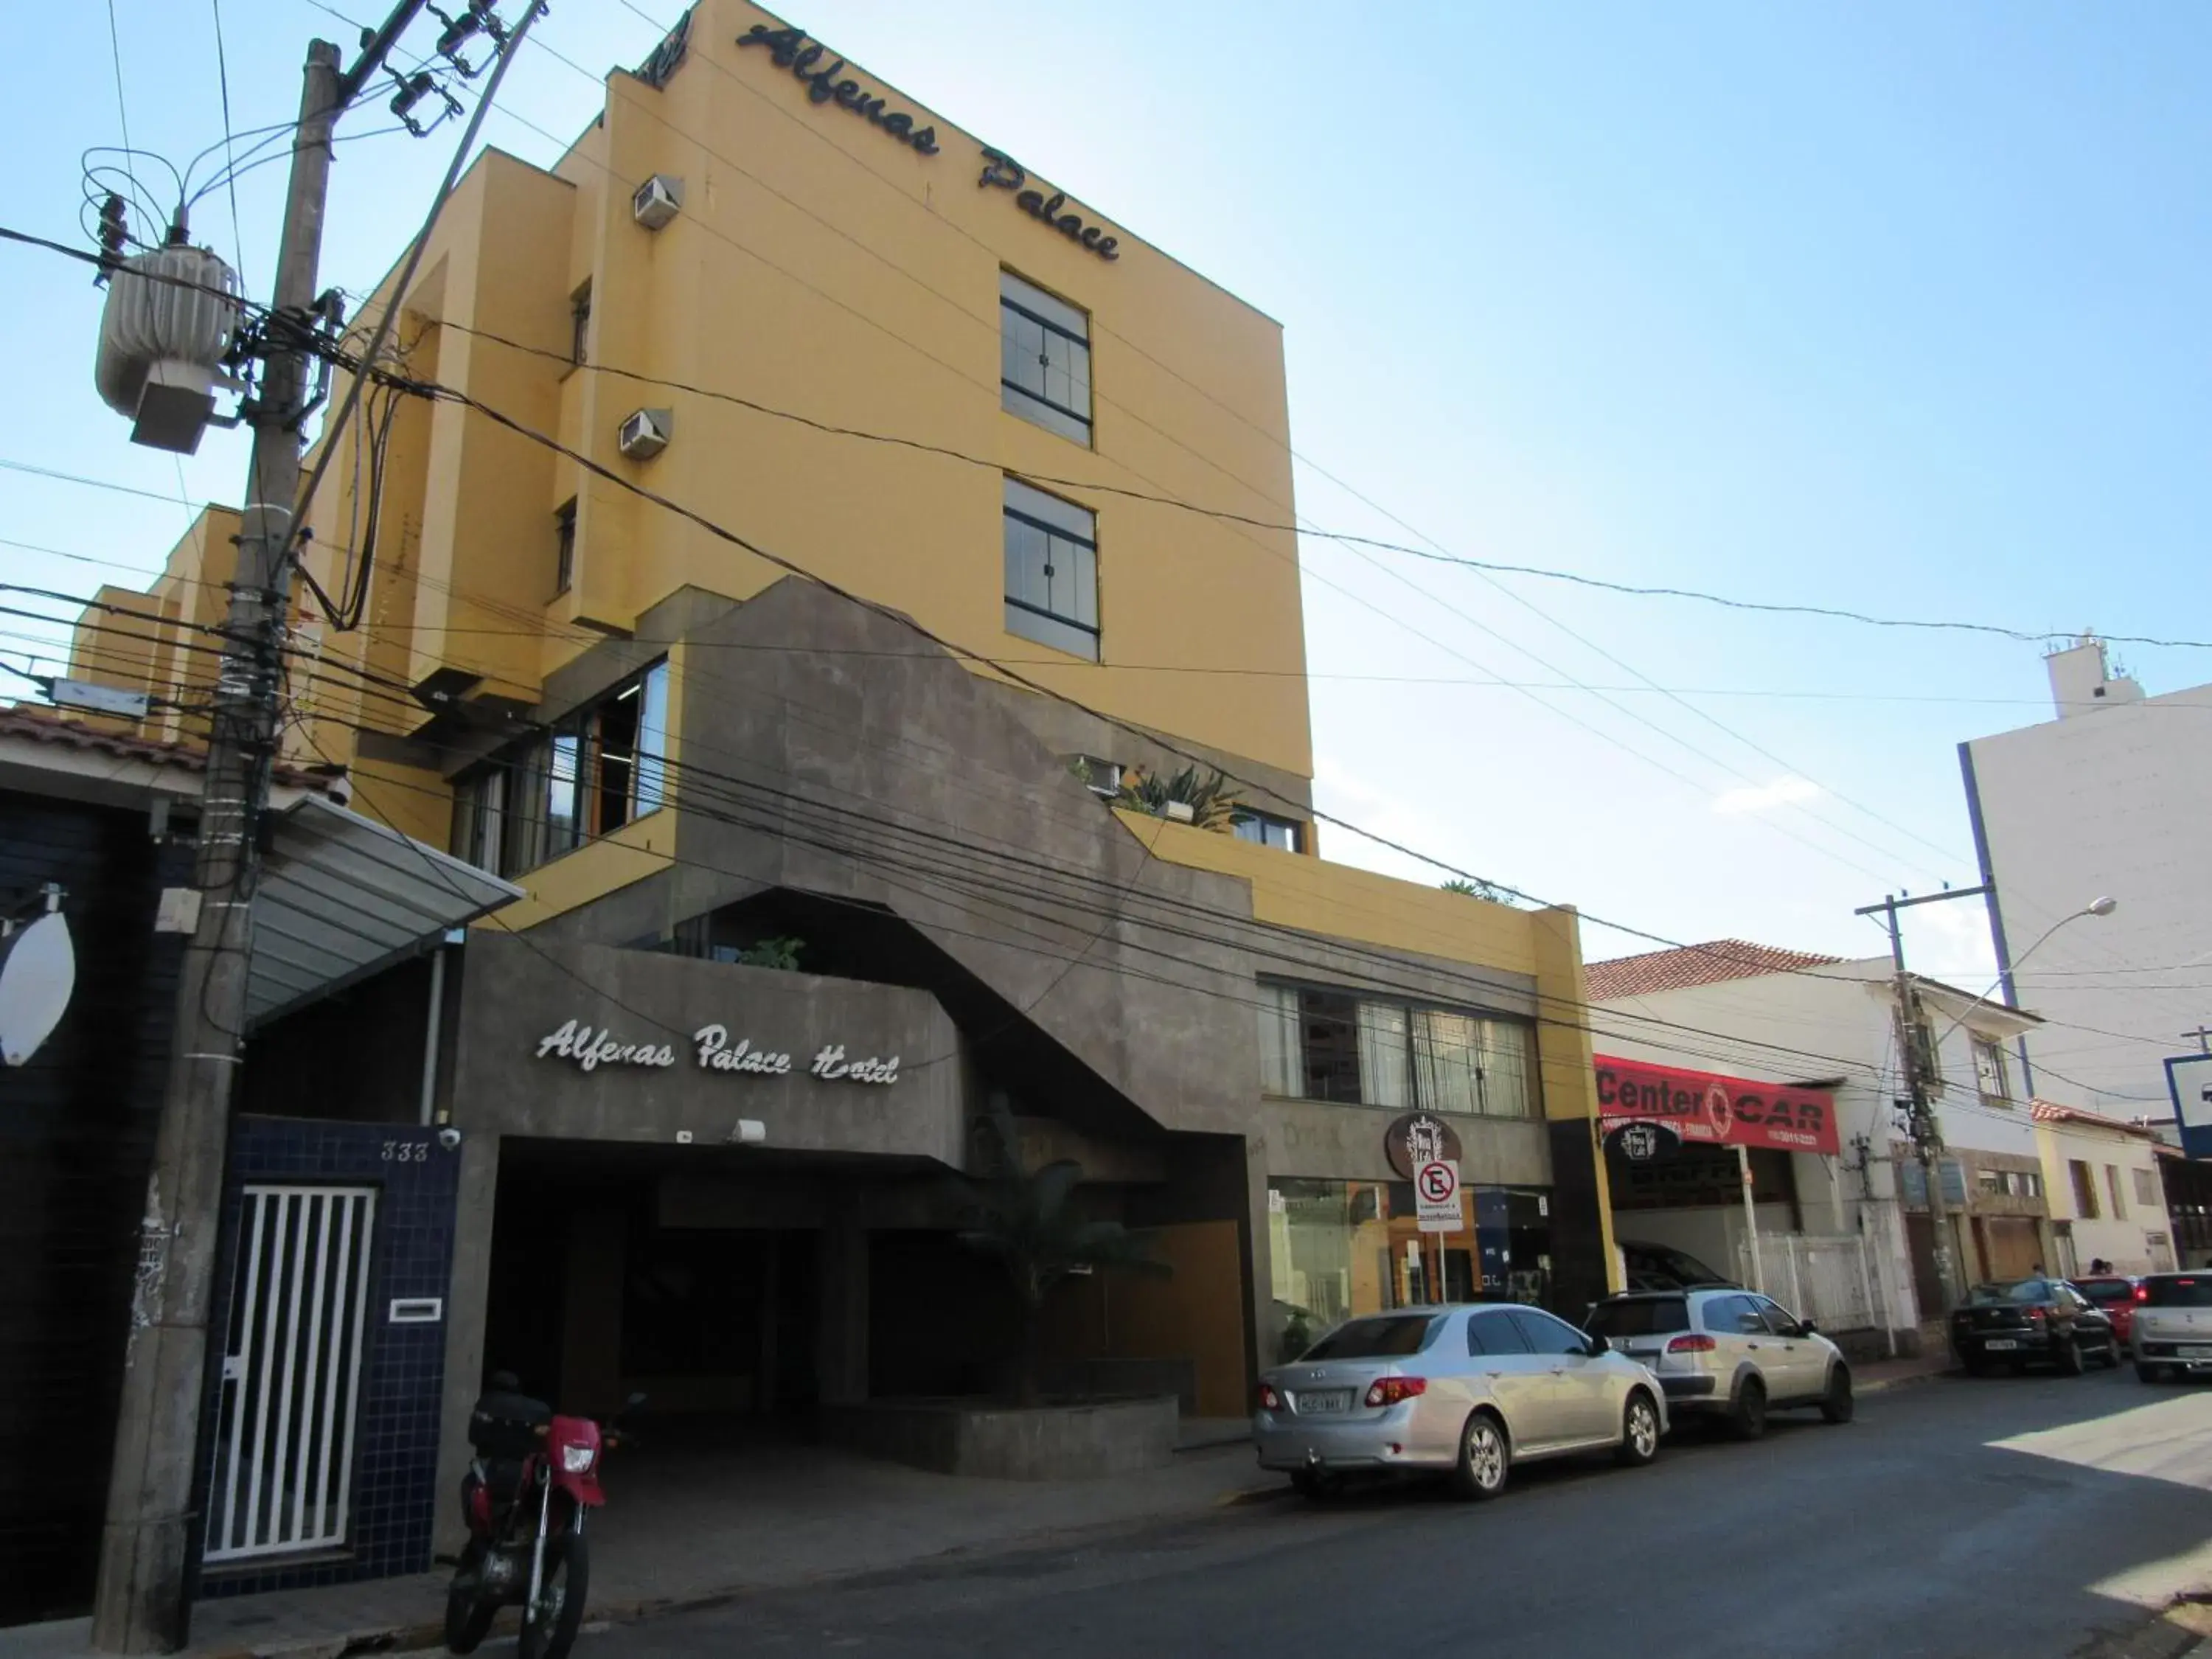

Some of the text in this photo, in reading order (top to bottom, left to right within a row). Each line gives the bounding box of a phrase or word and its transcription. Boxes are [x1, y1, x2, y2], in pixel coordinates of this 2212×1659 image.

[736, 24, 939, 155] Alfenas
[978, 147, 1120, 260] Palace
[536, 1019, 900, 1085] Alfenas Palace Hotel
[1596, 1066, 1705, 1116] Center
[1734, 1094, 1824, 1131] CAR
[380, 1141, 429, 1162] 333
